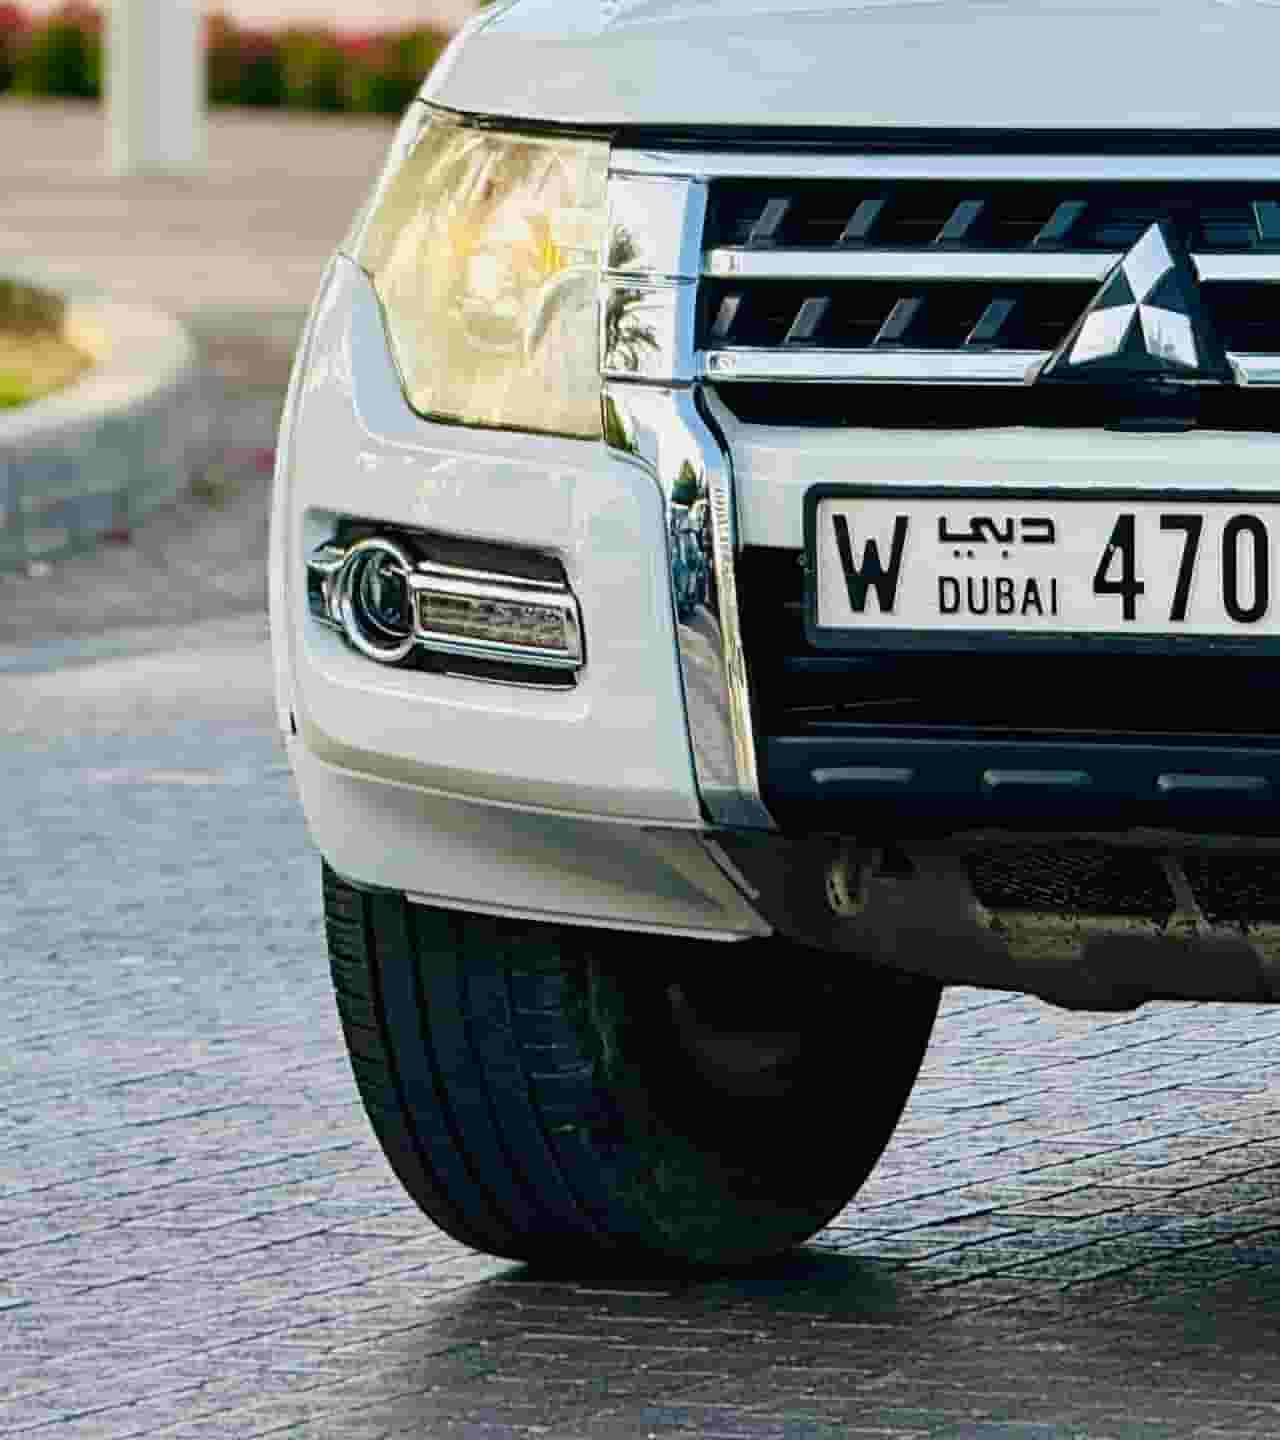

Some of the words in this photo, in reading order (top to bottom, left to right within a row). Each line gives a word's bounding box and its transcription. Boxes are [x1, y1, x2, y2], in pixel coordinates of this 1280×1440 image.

[938, 516, 1056, 559] دبي
[832, 514, 909, 613] W
[938, 576, 1058, 616] DUBAI
